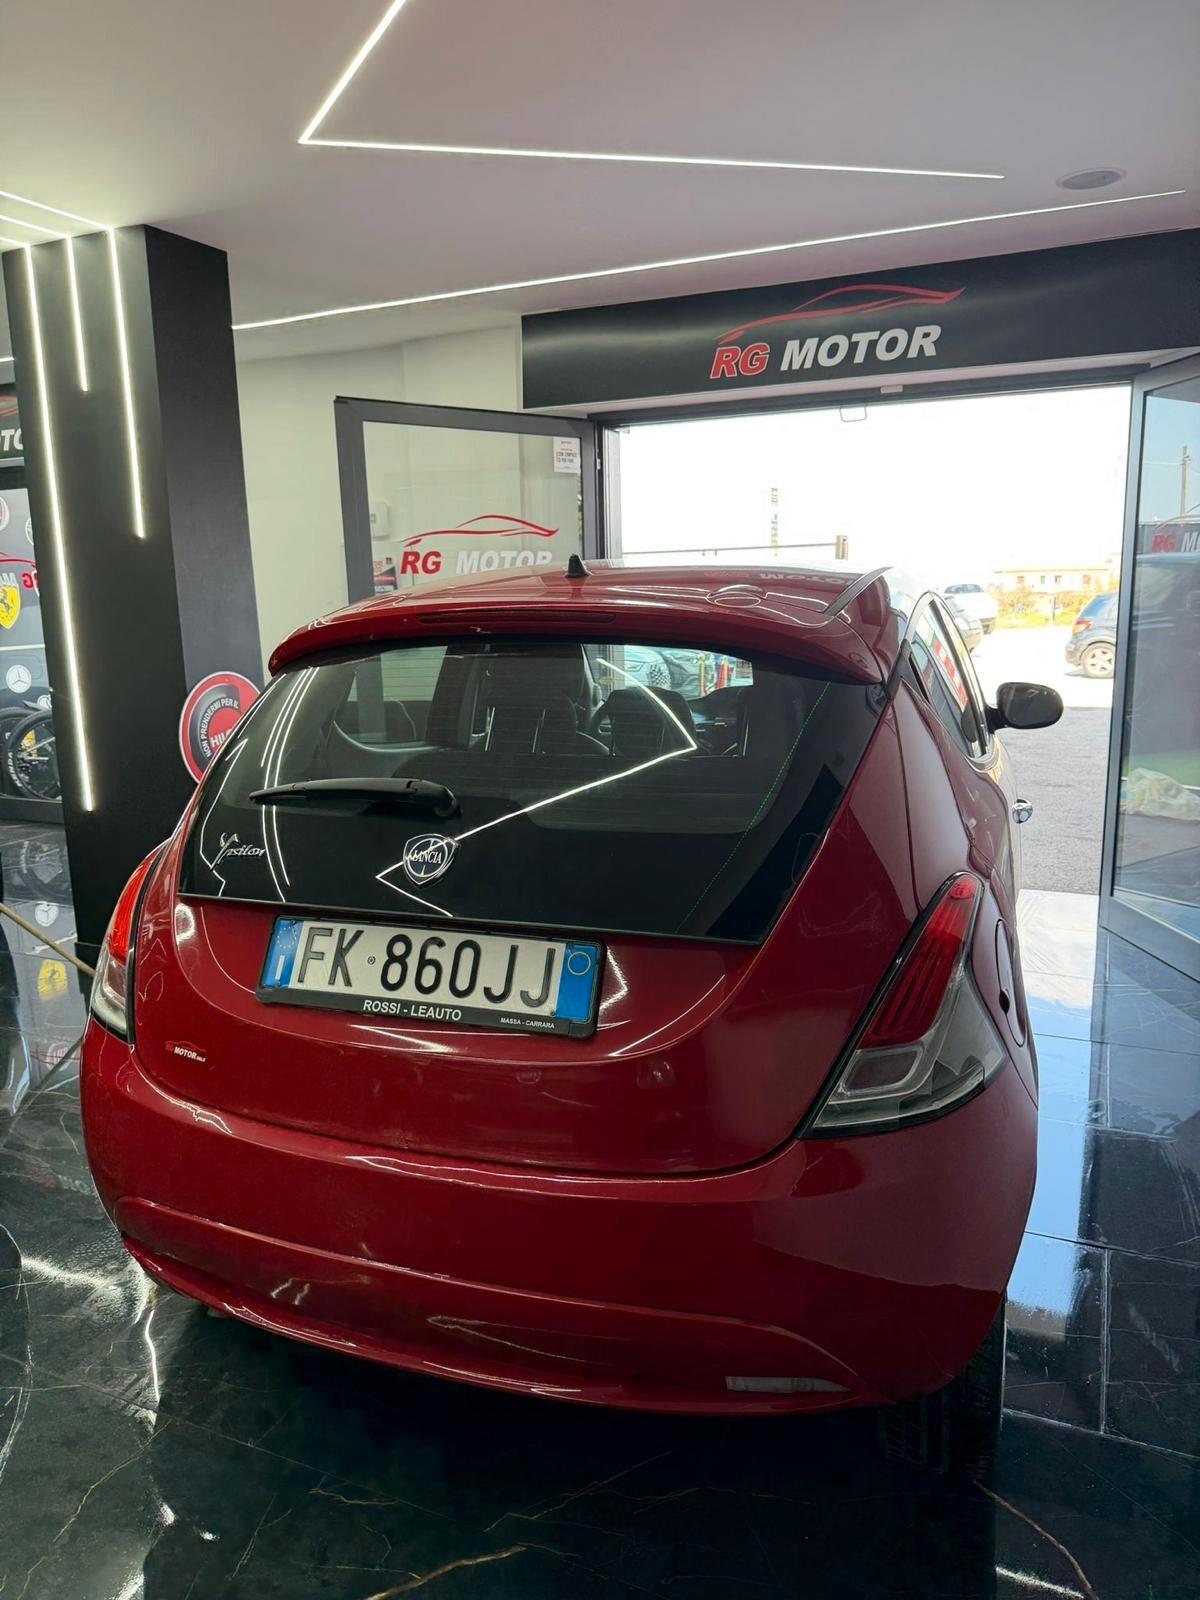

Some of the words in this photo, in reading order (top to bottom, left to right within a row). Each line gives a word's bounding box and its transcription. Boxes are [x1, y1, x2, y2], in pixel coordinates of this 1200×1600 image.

[709, 343, 770, 379] RG
[780, 324, 942, 371] MOTOR
[400, 550, 442, 574] RG
[220, 698, 233, 707] PER
[200, 701, 221, 739] PRENDERMI
[201, 740, 213, 758] NON
[410, 850, 442, 863] LANCIA
[363, 1000, 400, 1014] ROSSI
[411, 1004, 462, 1021] LEAUTO
[500, 1017, 521, 1025] MASSA
[525, 1020, 555, 1029] CARRARA
[174, 1046, 197, 1060] MOTOR
